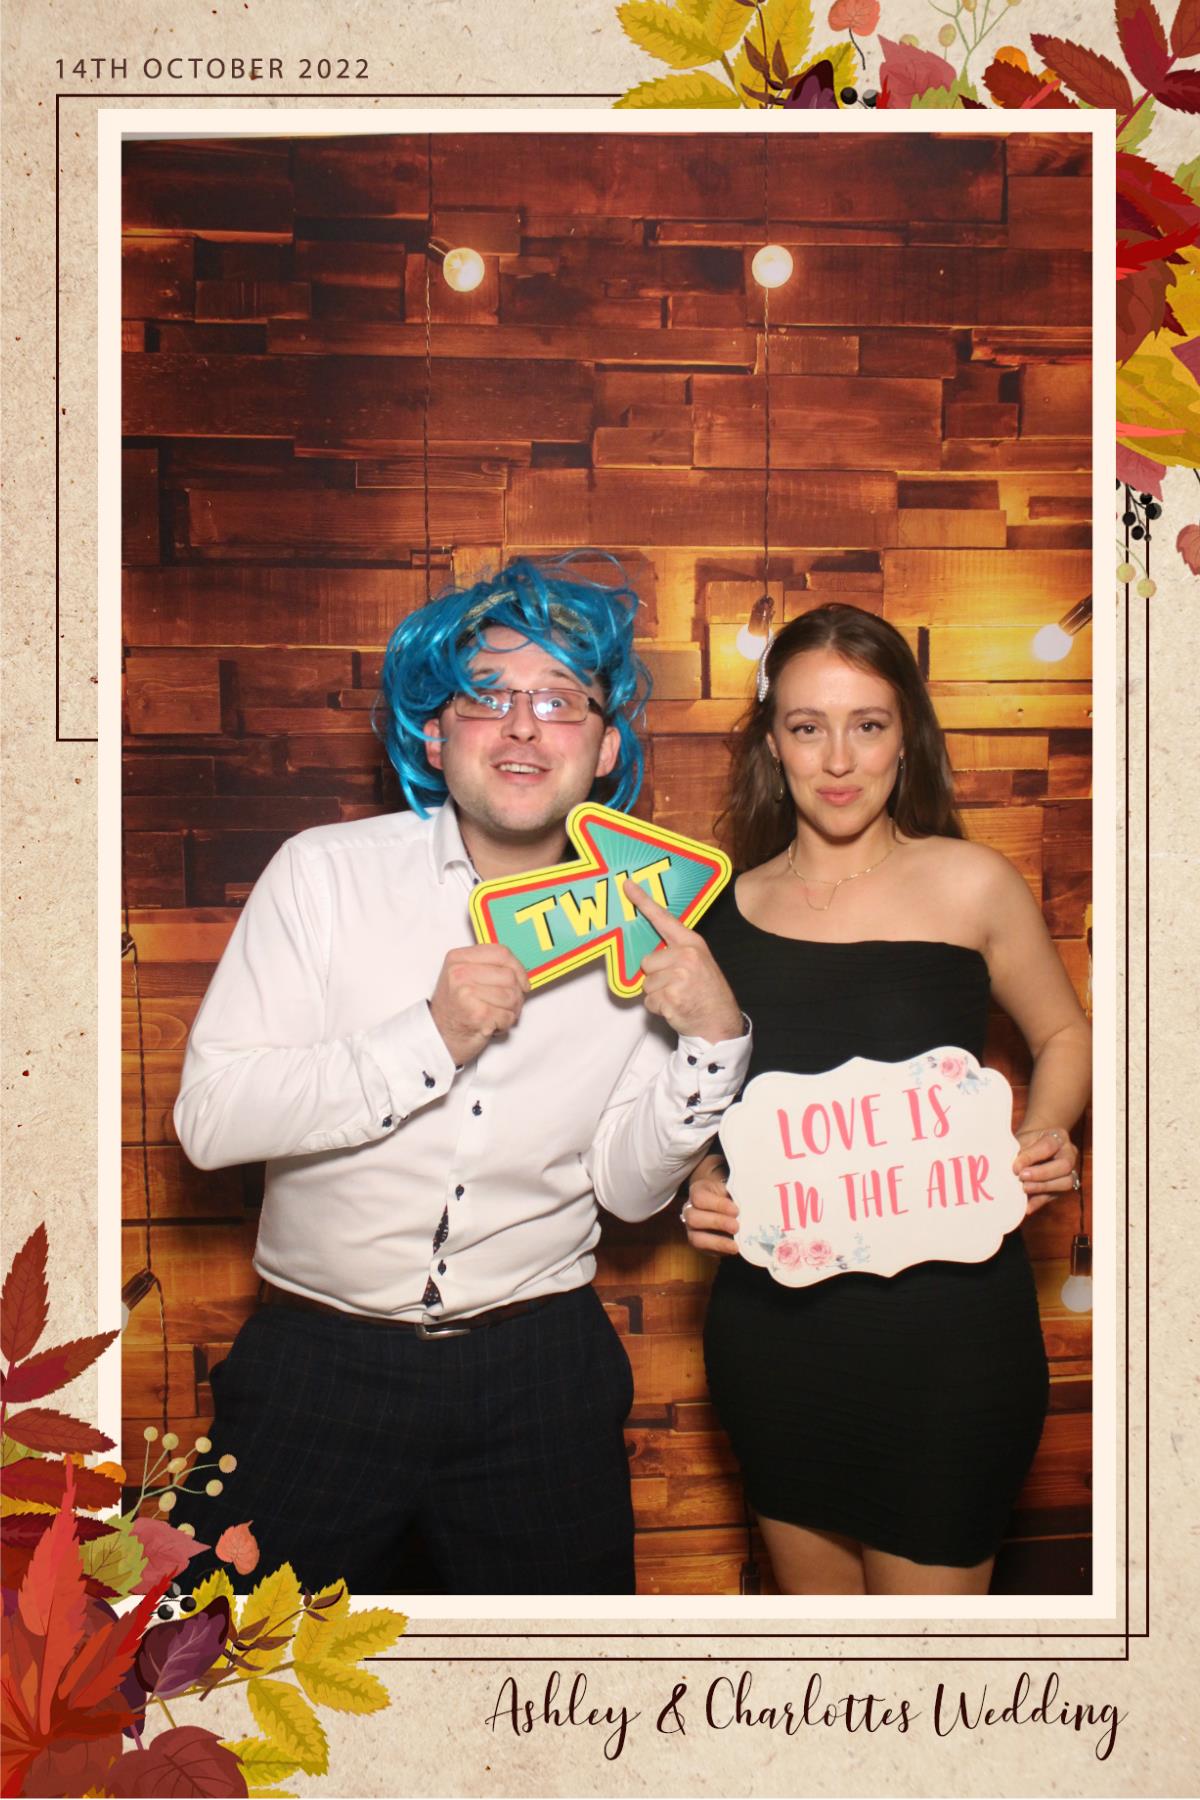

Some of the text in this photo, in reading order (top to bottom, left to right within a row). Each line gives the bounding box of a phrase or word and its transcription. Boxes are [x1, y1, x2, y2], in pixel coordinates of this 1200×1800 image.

[513, 855, 673, 952] TWIT
[776, 1084, 951, 1160] LOVE IS
[838, 1165, 909, 1222] THE
[926, 1154, 995, 1209] AIR
